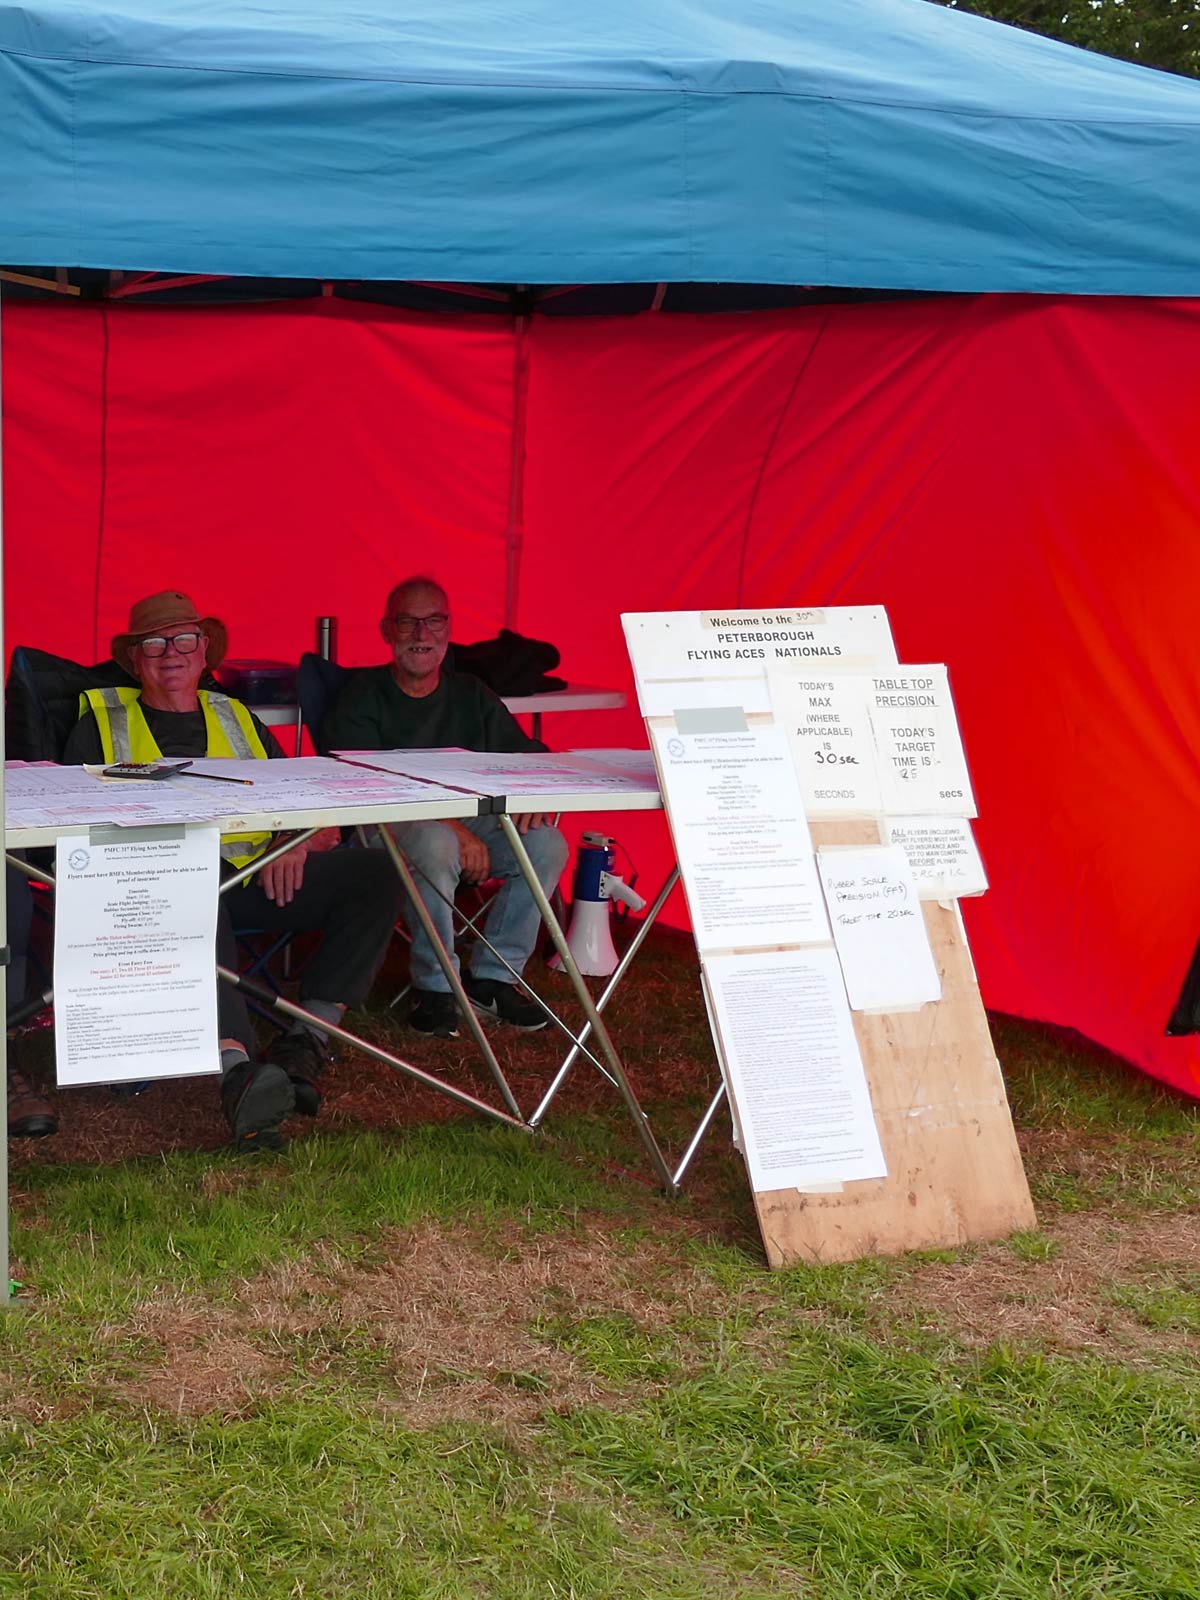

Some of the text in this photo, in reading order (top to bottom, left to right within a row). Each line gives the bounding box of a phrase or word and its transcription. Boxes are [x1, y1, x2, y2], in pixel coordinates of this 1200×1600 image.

[710, 616, 760, 627] Welcome
[762, 615, 773, 625] to
[775, 614, 793, 624] the
[717, 631, 815, 643] PETERBOROUGH
[687, 646, 842, 660] FLYING ACES NATIONALS
[798, 682, 834, 691] TODAY'S
[872, 678, 933, 690] TABLE TOP
[808, 697, 832, 707] MAX
[875, 695, 936, 706] PRECISION
[806, 714, 840, 724] (WHERE
[796, 727, 853, 737] APPLICABLE)
[890, 728, 935, 738] TODAY'S
[823, 742, 832, 750] IS
[895, 742, 935, 752] TARGET
[892, 757, 917, 767] TIME
[921, 756, 931, 766] IS
[814, 790, 855, 799] SECONDS
[939, 790, 963, 798] secs
[891, 829, 906, 837] ALL
[130, 845, 146, 853] Flying
[909, 858, 935, 866] BEFORE
[126, 869, 155, 877] Membership
